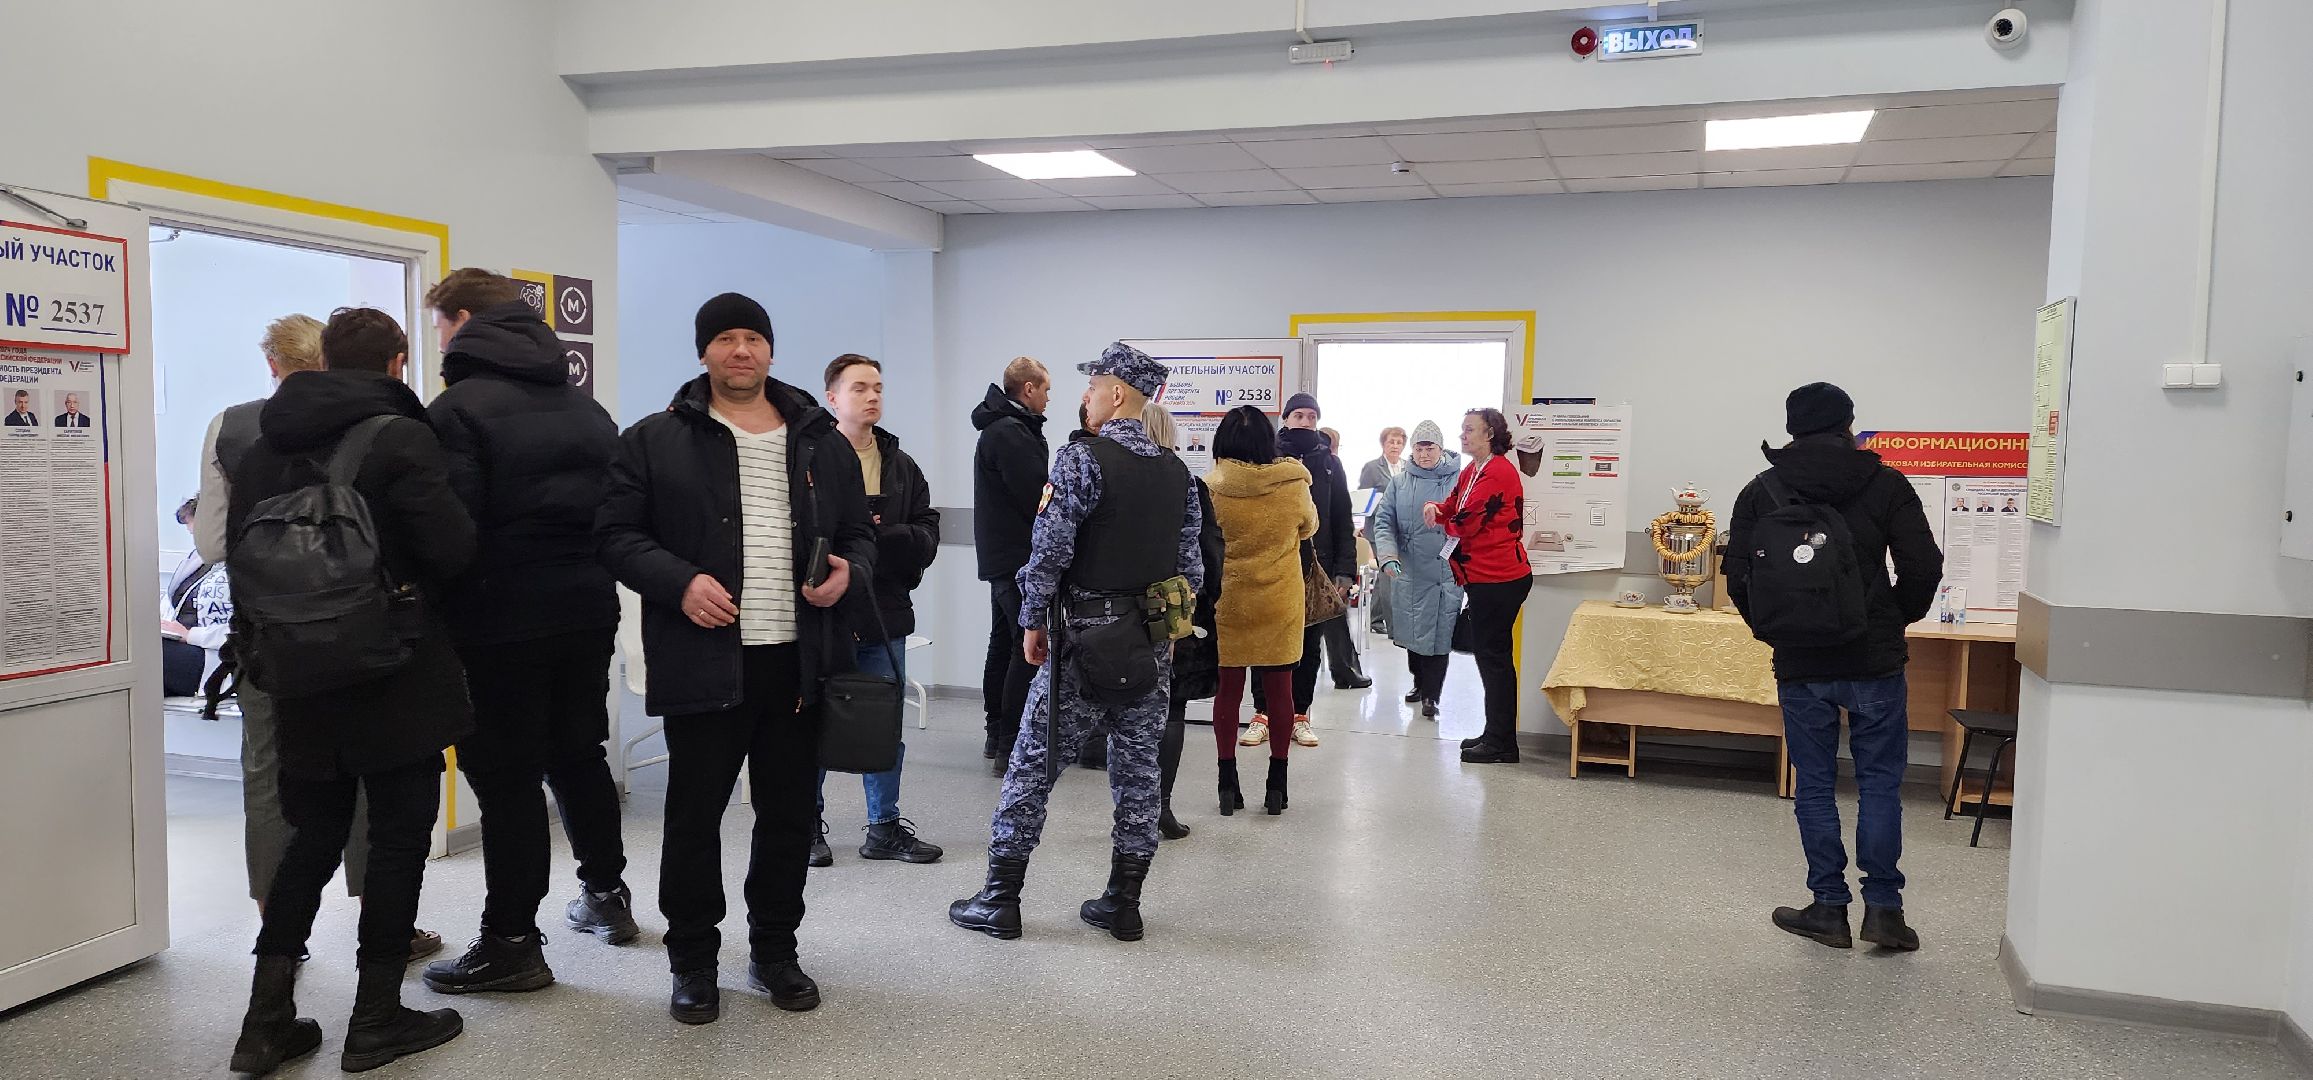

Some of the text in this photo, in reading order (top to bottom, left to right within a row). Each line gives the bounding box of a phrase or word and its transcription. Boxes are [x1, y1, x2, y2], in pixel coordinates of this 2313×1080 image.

[1608, 28, 1695, 53] ВЫХОД
[30, 244, 116, 272] УЧАСТОК
[6, 293, 104, 327] № 2537
[21, 366, 62, 375] ПРЕЗИДЕНТА
[1229, 365, 1275, 375] УЧАСТОК
[1216, 389, 1272, 405] № 2538
[1920, 460, 1991, 468] ИЗБИРАТЕЛЬНАЯ
